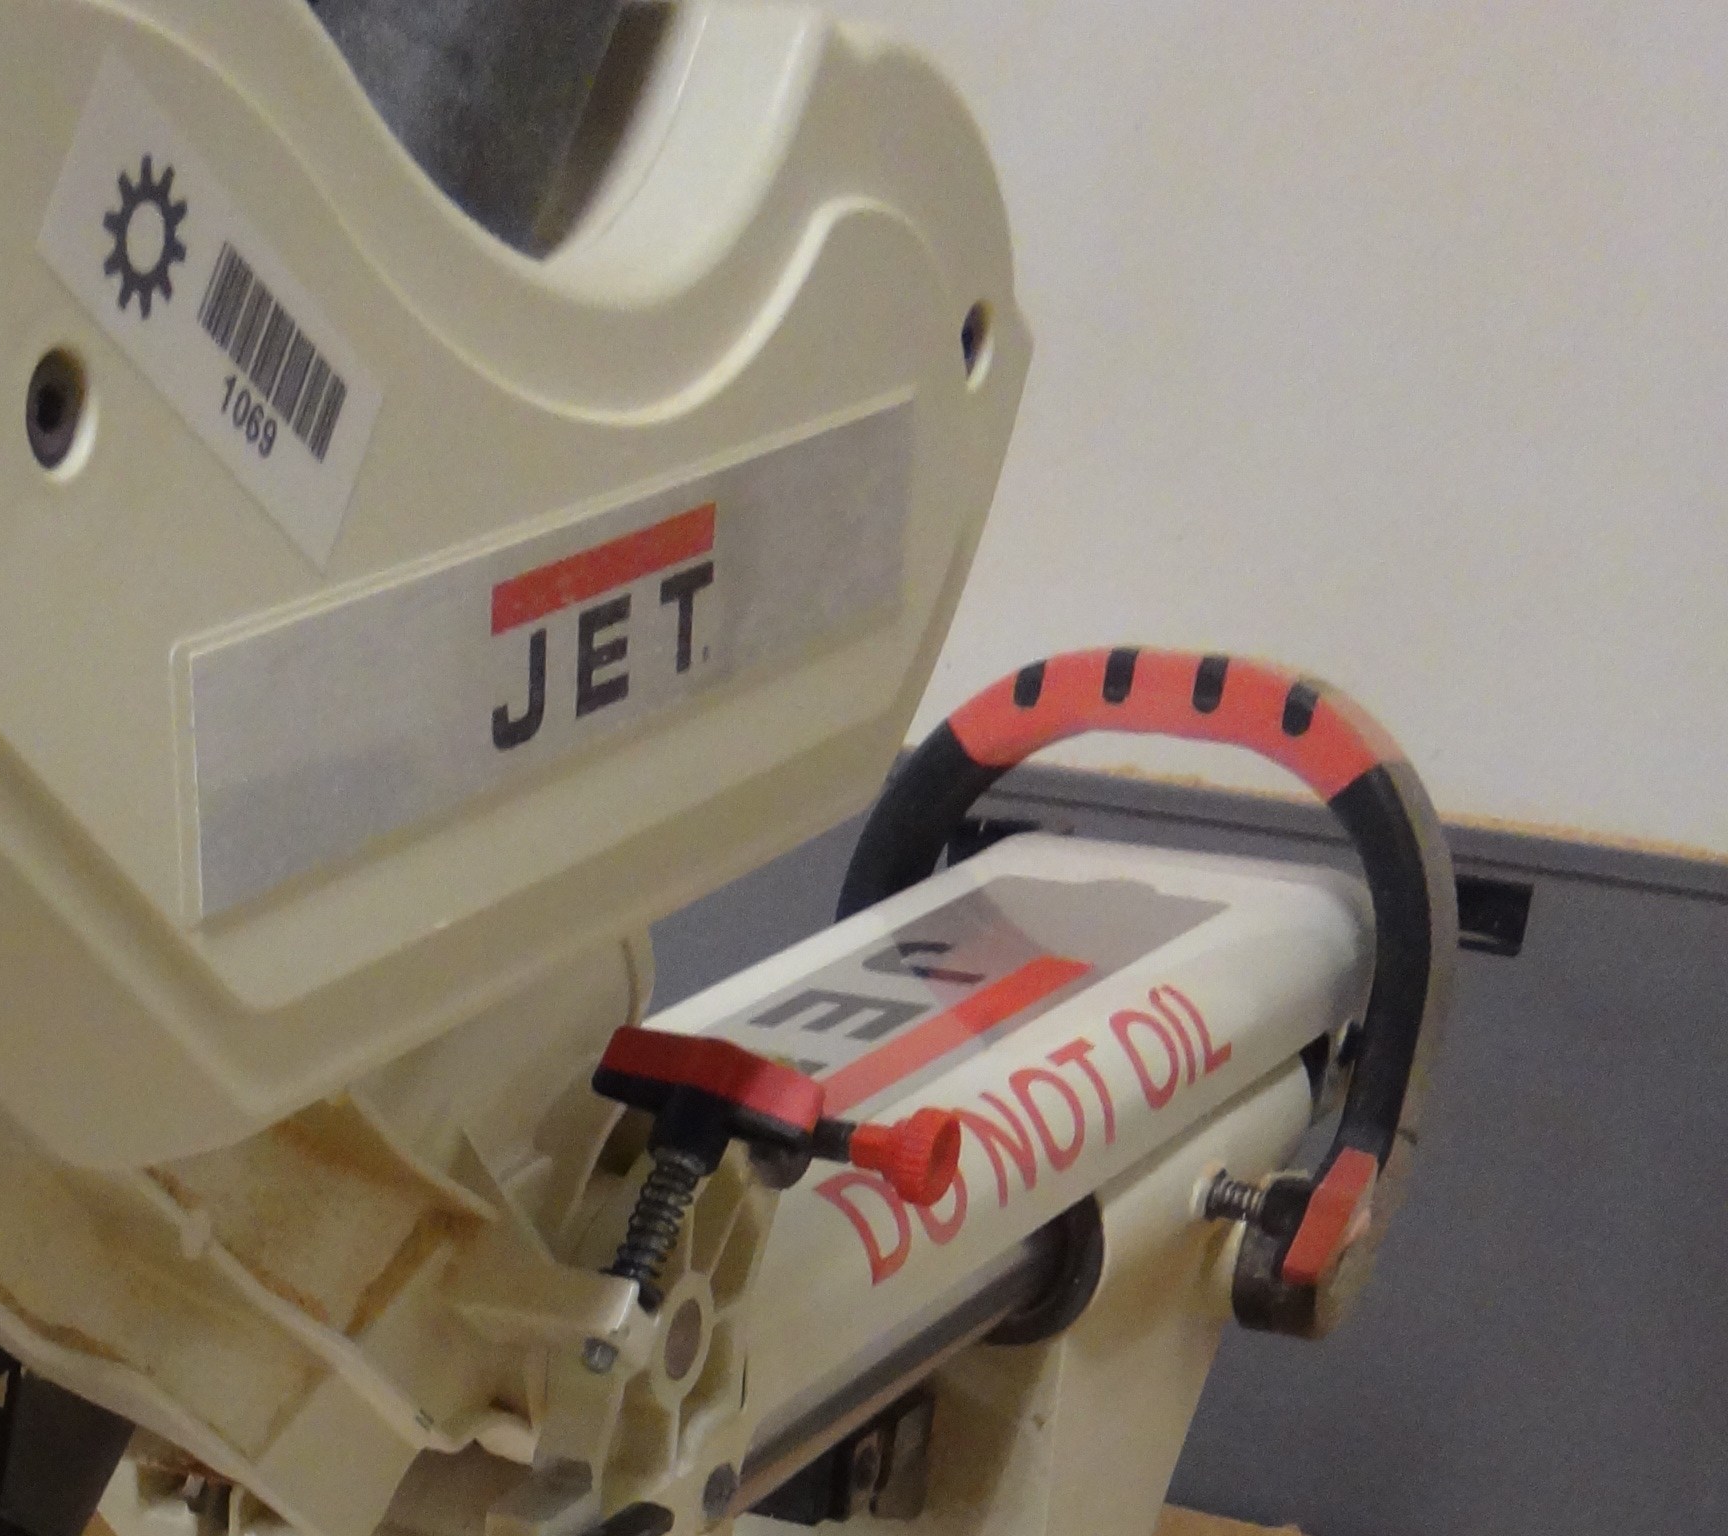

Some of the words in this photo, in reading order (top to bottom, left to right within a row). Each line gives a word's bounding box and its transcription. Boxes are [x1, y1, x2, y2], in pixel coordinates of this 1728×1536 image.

[221, 374, 278, 458] 1069
[491, 560, 715, 752] JET
[953, 1035, 1117, 1208] NOT
[1108, 983, 1233, 1110] OIL
